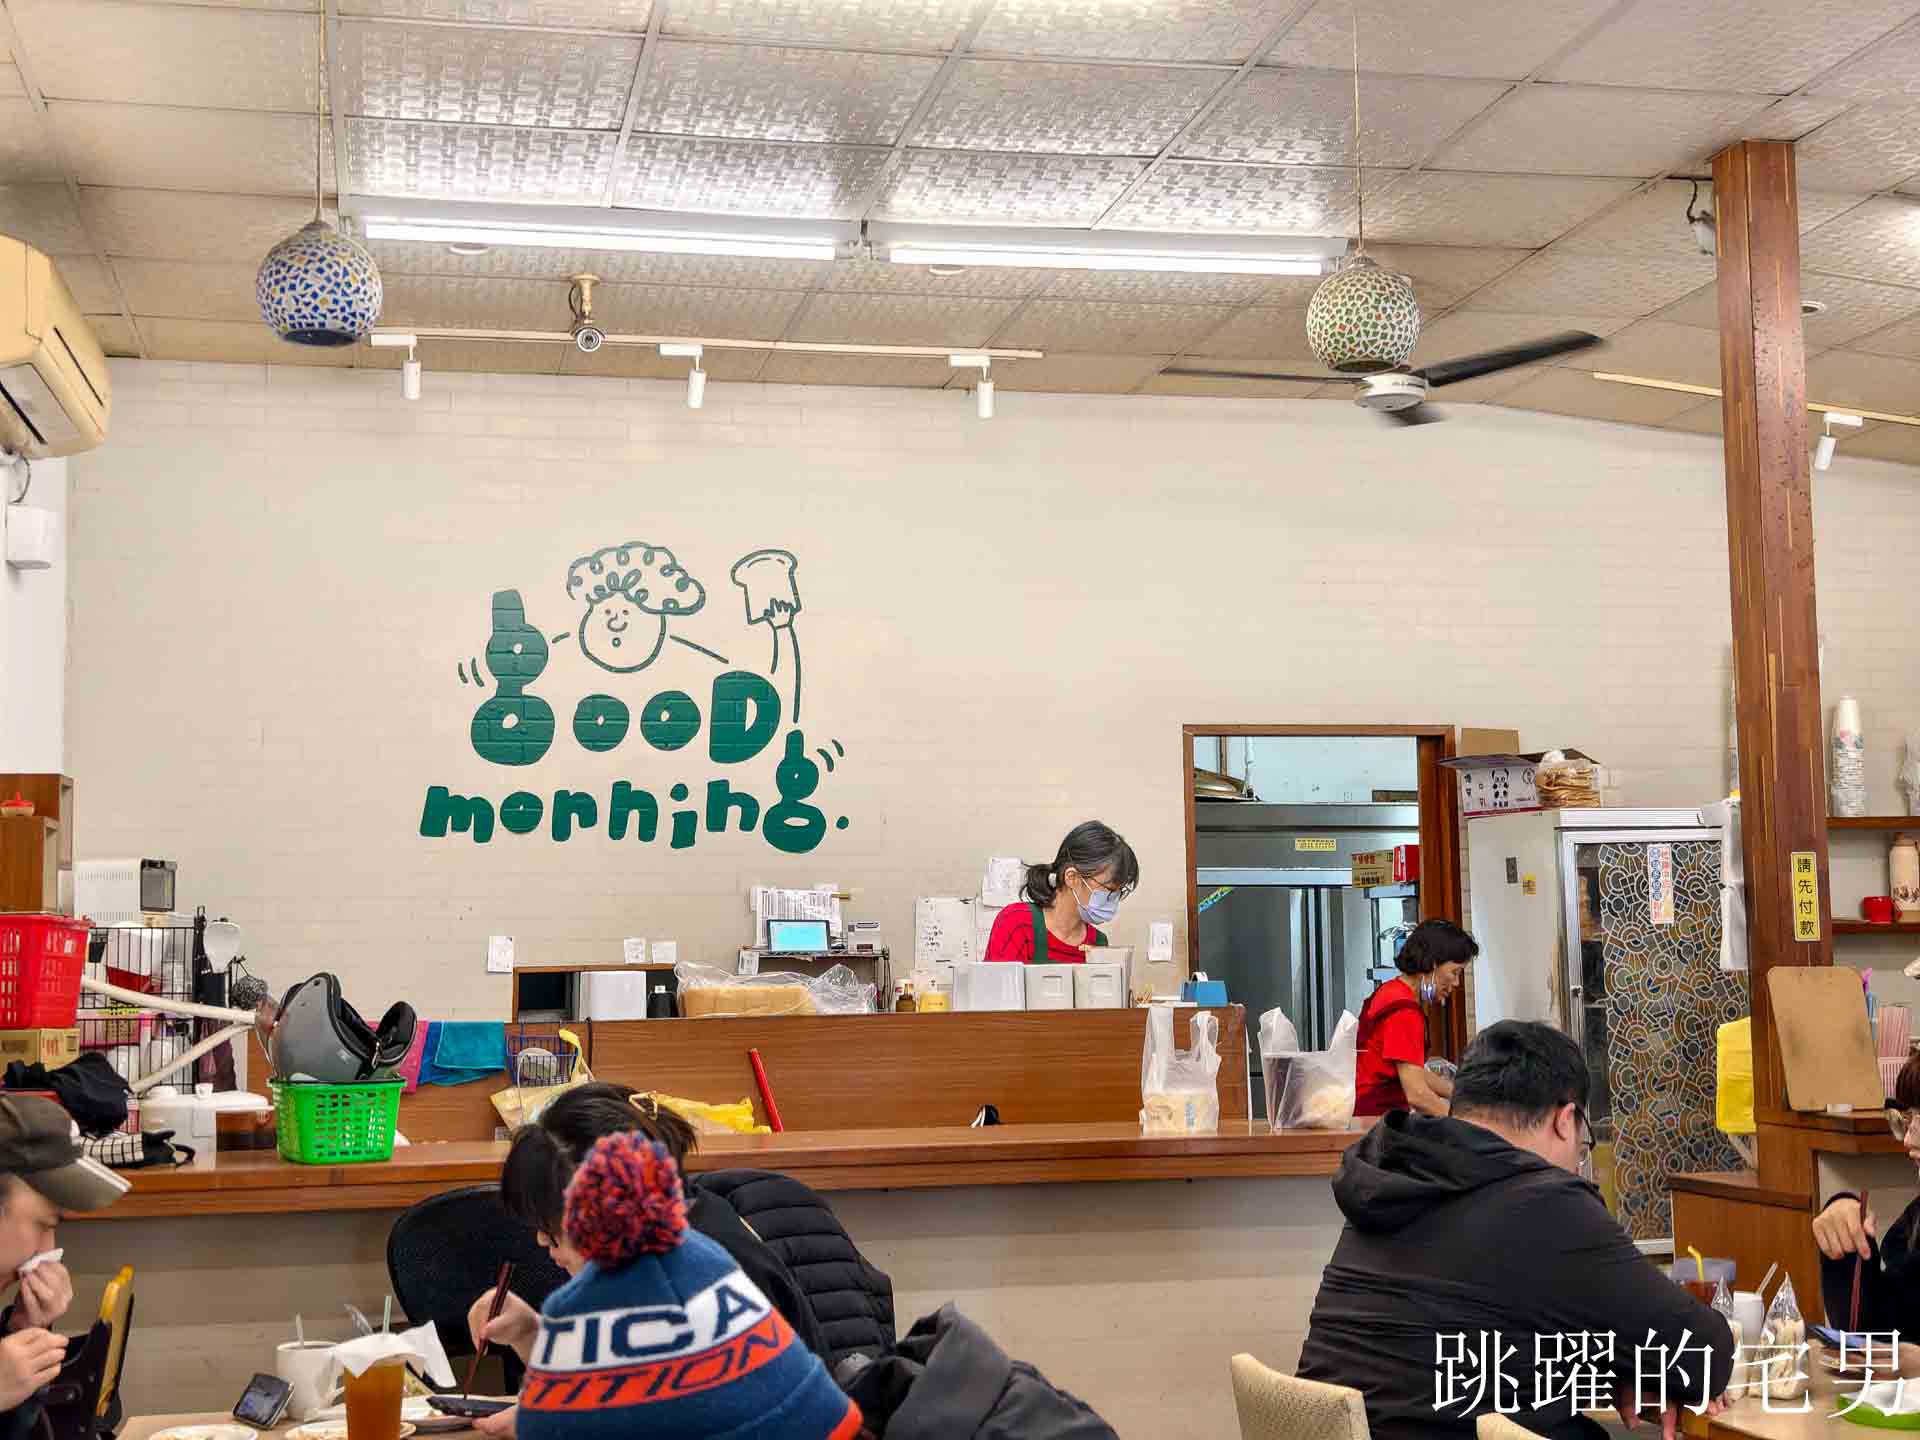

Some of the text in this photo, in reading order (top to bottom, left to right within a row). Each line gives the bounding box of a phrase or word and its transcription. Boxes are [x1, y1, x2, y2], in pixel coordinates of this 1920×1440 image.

[1797, 857, 1815, 936] 請先付款
[527, 1322, 779, 1405] TITION
[541, 1284, 762, 1365] TICA
